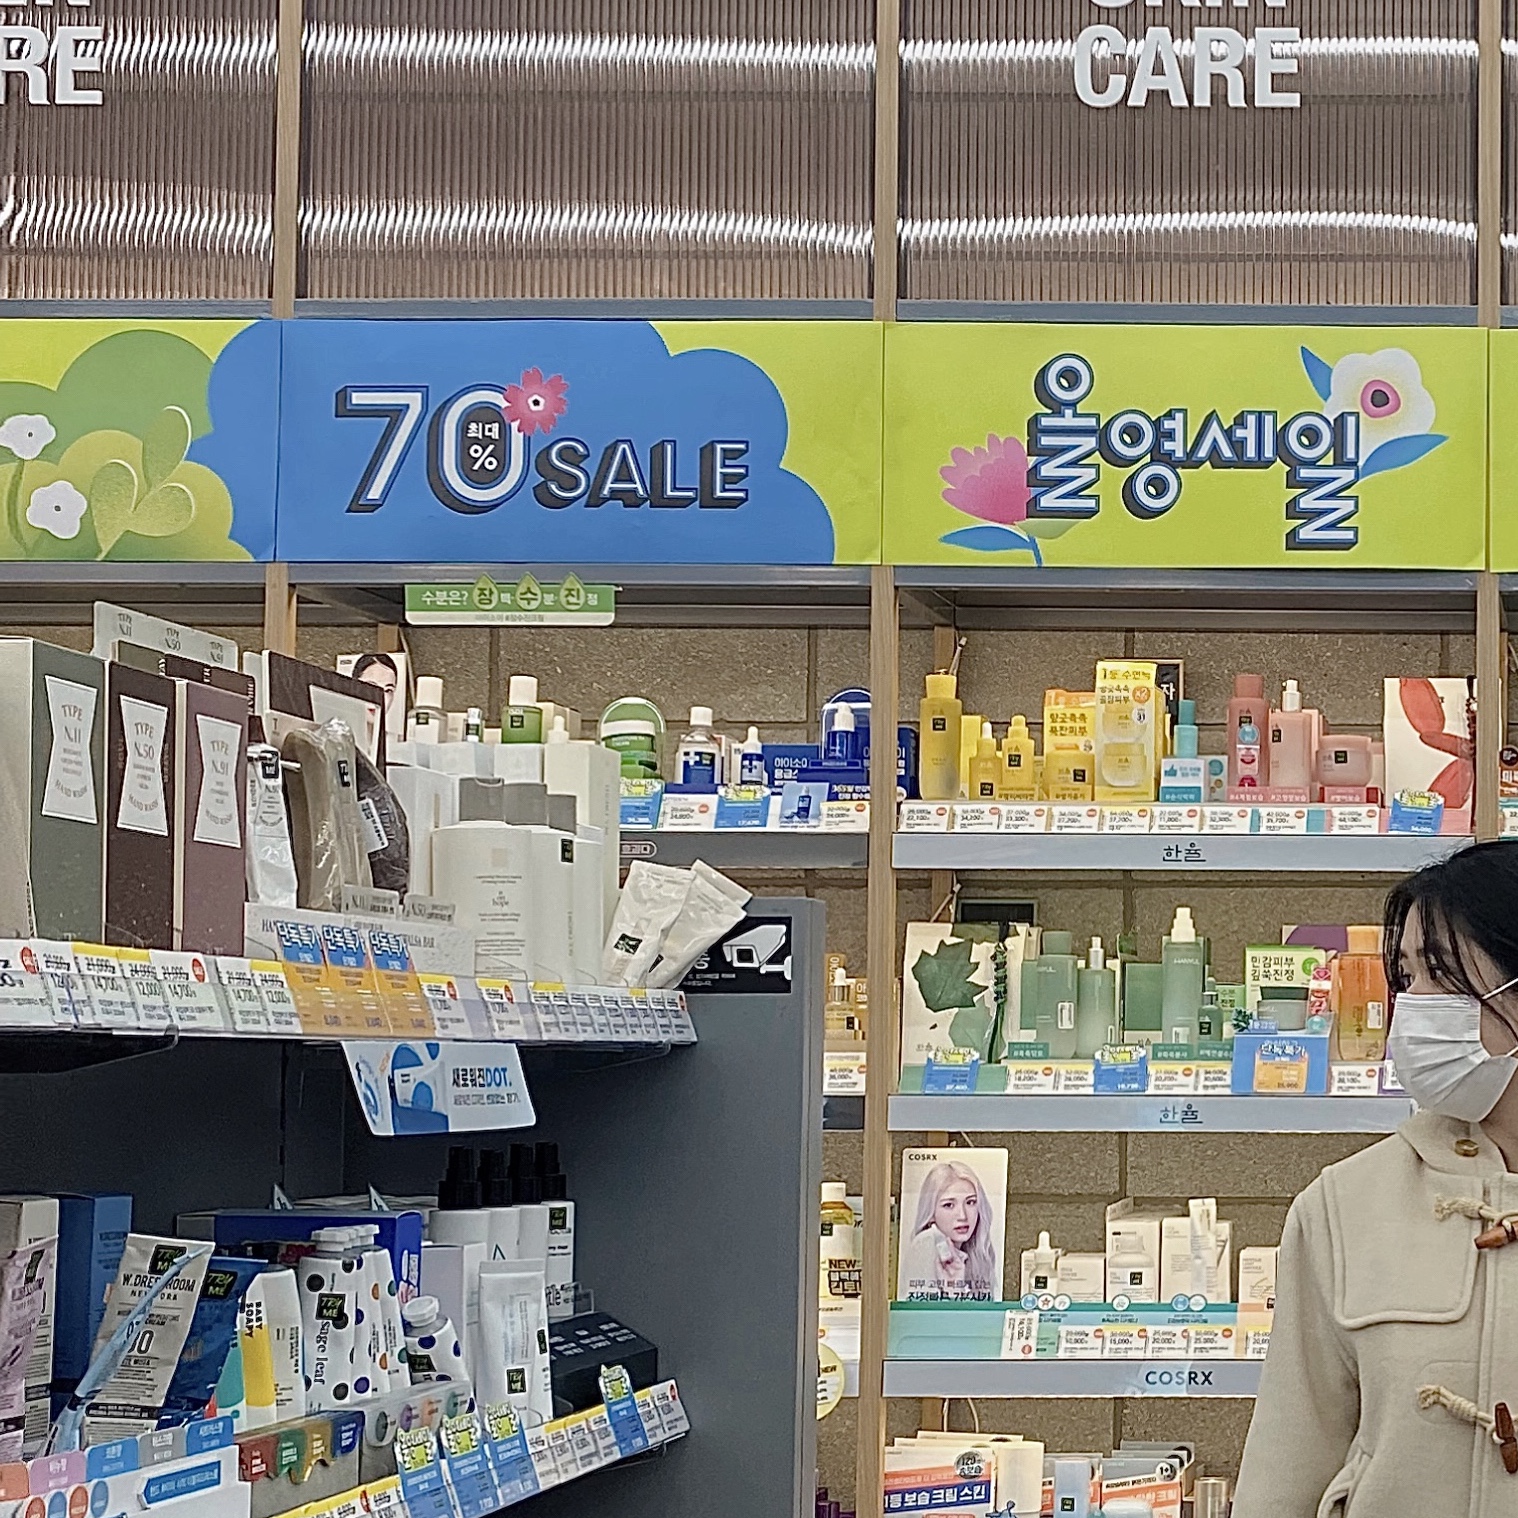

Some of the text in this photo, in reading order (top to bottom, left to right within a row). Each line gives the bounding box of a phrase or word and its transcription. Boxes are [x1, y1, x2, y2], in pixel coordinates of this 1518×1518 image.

[1073, 24, 1301, 108] CARE
[467, 421, 500, 440] 최대
[334, 384, 750, 516] 70 SALE
[469, 443, 499, 472] %
[1026, 353, 1360, 552] 올영세일
[421, 590, 468, 605] 수분은?
[61, 704, 84, 721] TYPE
[1162, 842, 1207, 862] 한율
[277, 920, 322, 949] 단독특가
[1251, 956, 1295, 969] 민감피부
[1159, 1103, 1204, 1124] 한율
[908, 1153, 938, 1162] COSRX
[829, 1259, 856, 1269] NEW
[208, 1271, 234, 1284] TRY
[208, 1285, 226, 1296] ME
[321, 1297, 343, 1308] TRY
[246, 1301, 255, 1339] SOAPY
[255, 1301, 263, 1330] BABY
[322, 1308, 339, 1318] ME
[313, 1320, 331, 1385] sage leaf
[1144, 1370, 1214, 1386] COSRX
[1159, 1466, 1174, 1476] 1+1
[904, 1490, 930, 1507] 보습
[932, 1487, 957, 1504] 크림
[959, 1483, 987, 1501] 스킨
